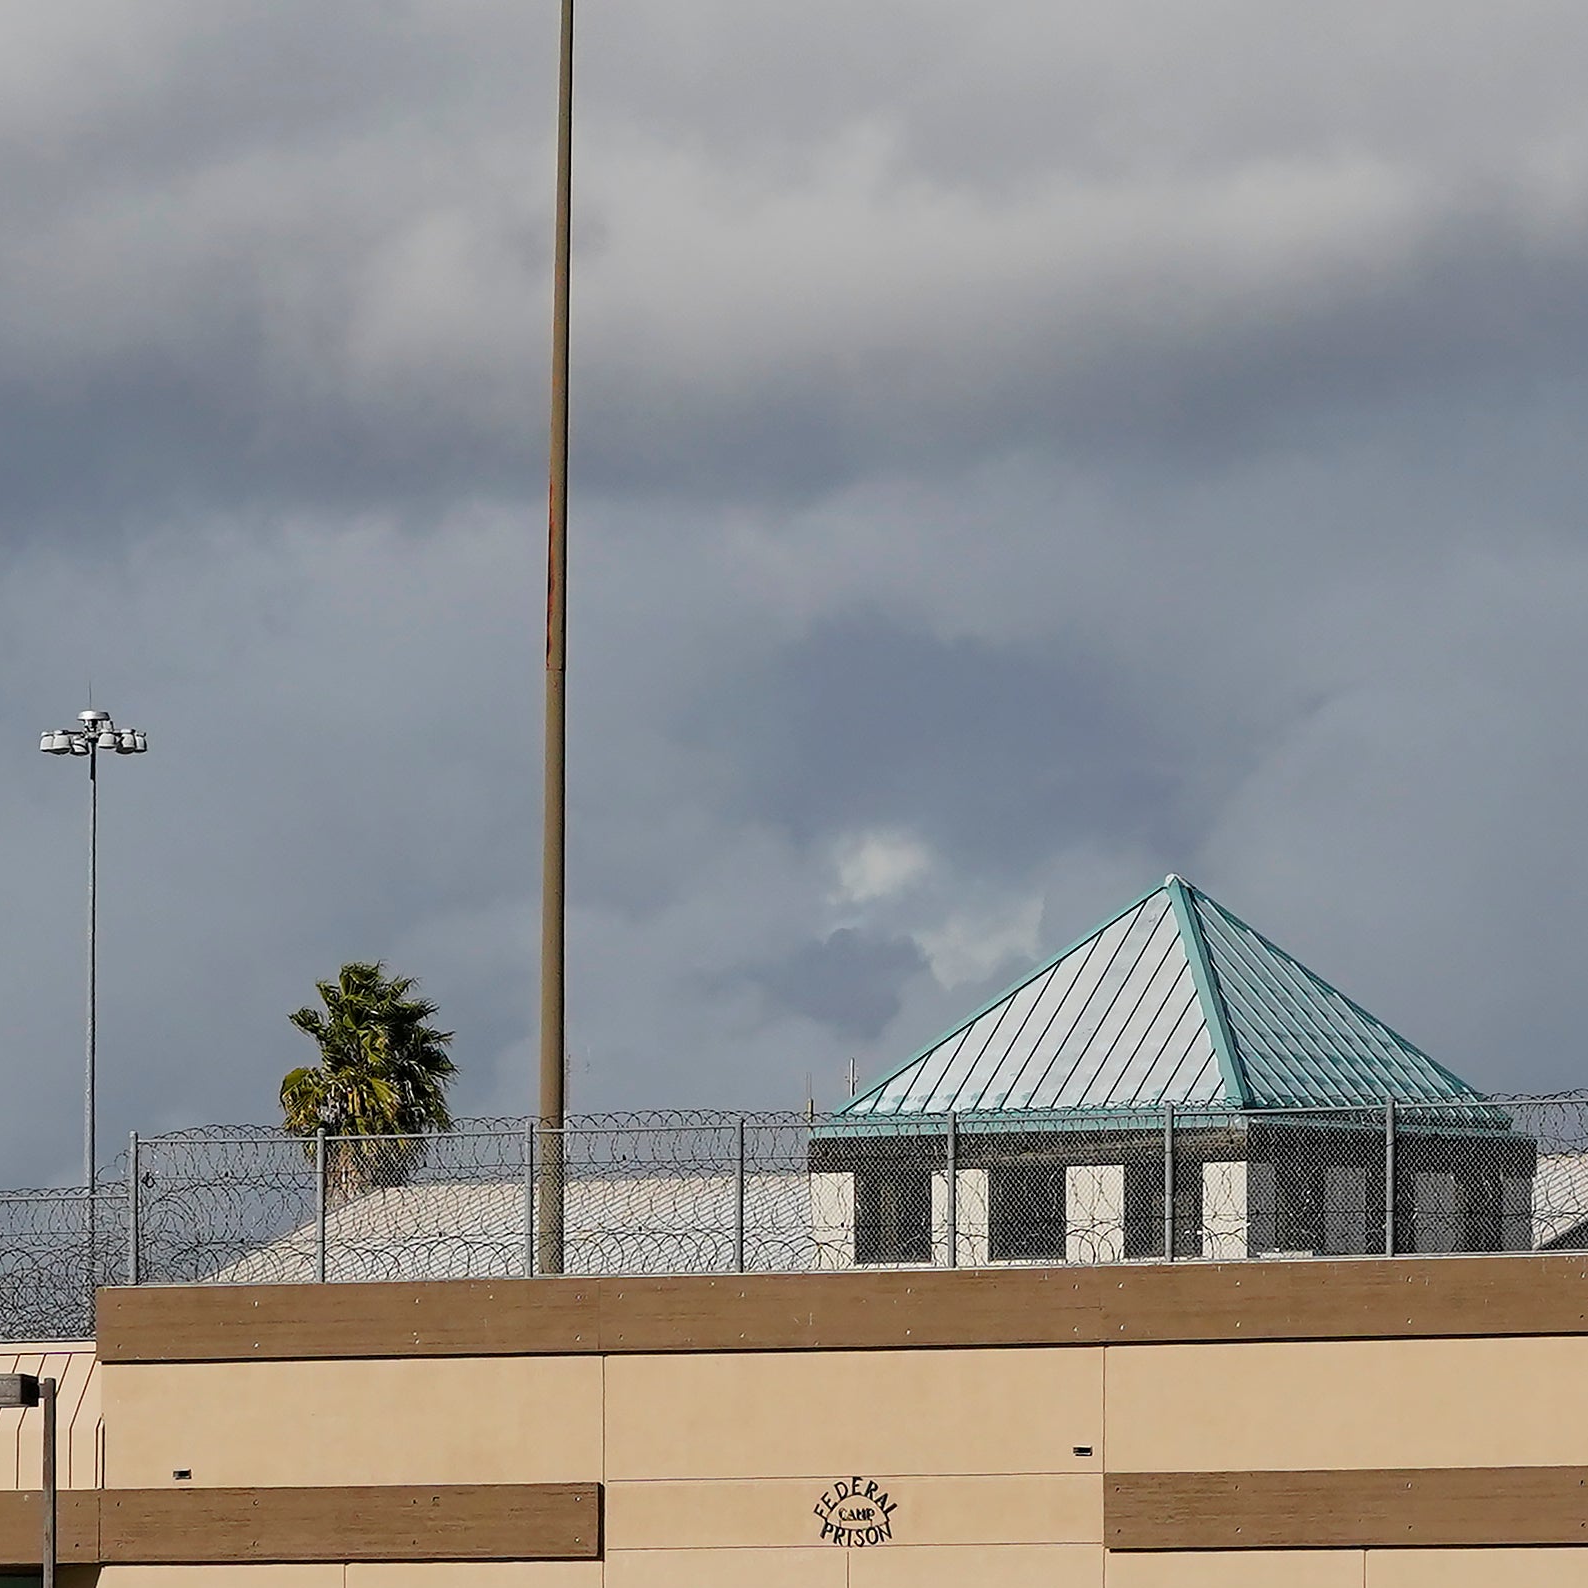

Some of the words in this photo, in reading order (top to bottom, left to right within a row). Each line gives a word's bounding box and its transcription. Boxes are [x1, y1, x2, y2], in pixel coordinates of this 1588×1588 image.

[813, 1476, 898, 1522] FEDERAL
[838, 1507, 876, 1521] CAMP
[819, 1521, 892, 1547] PRISON
